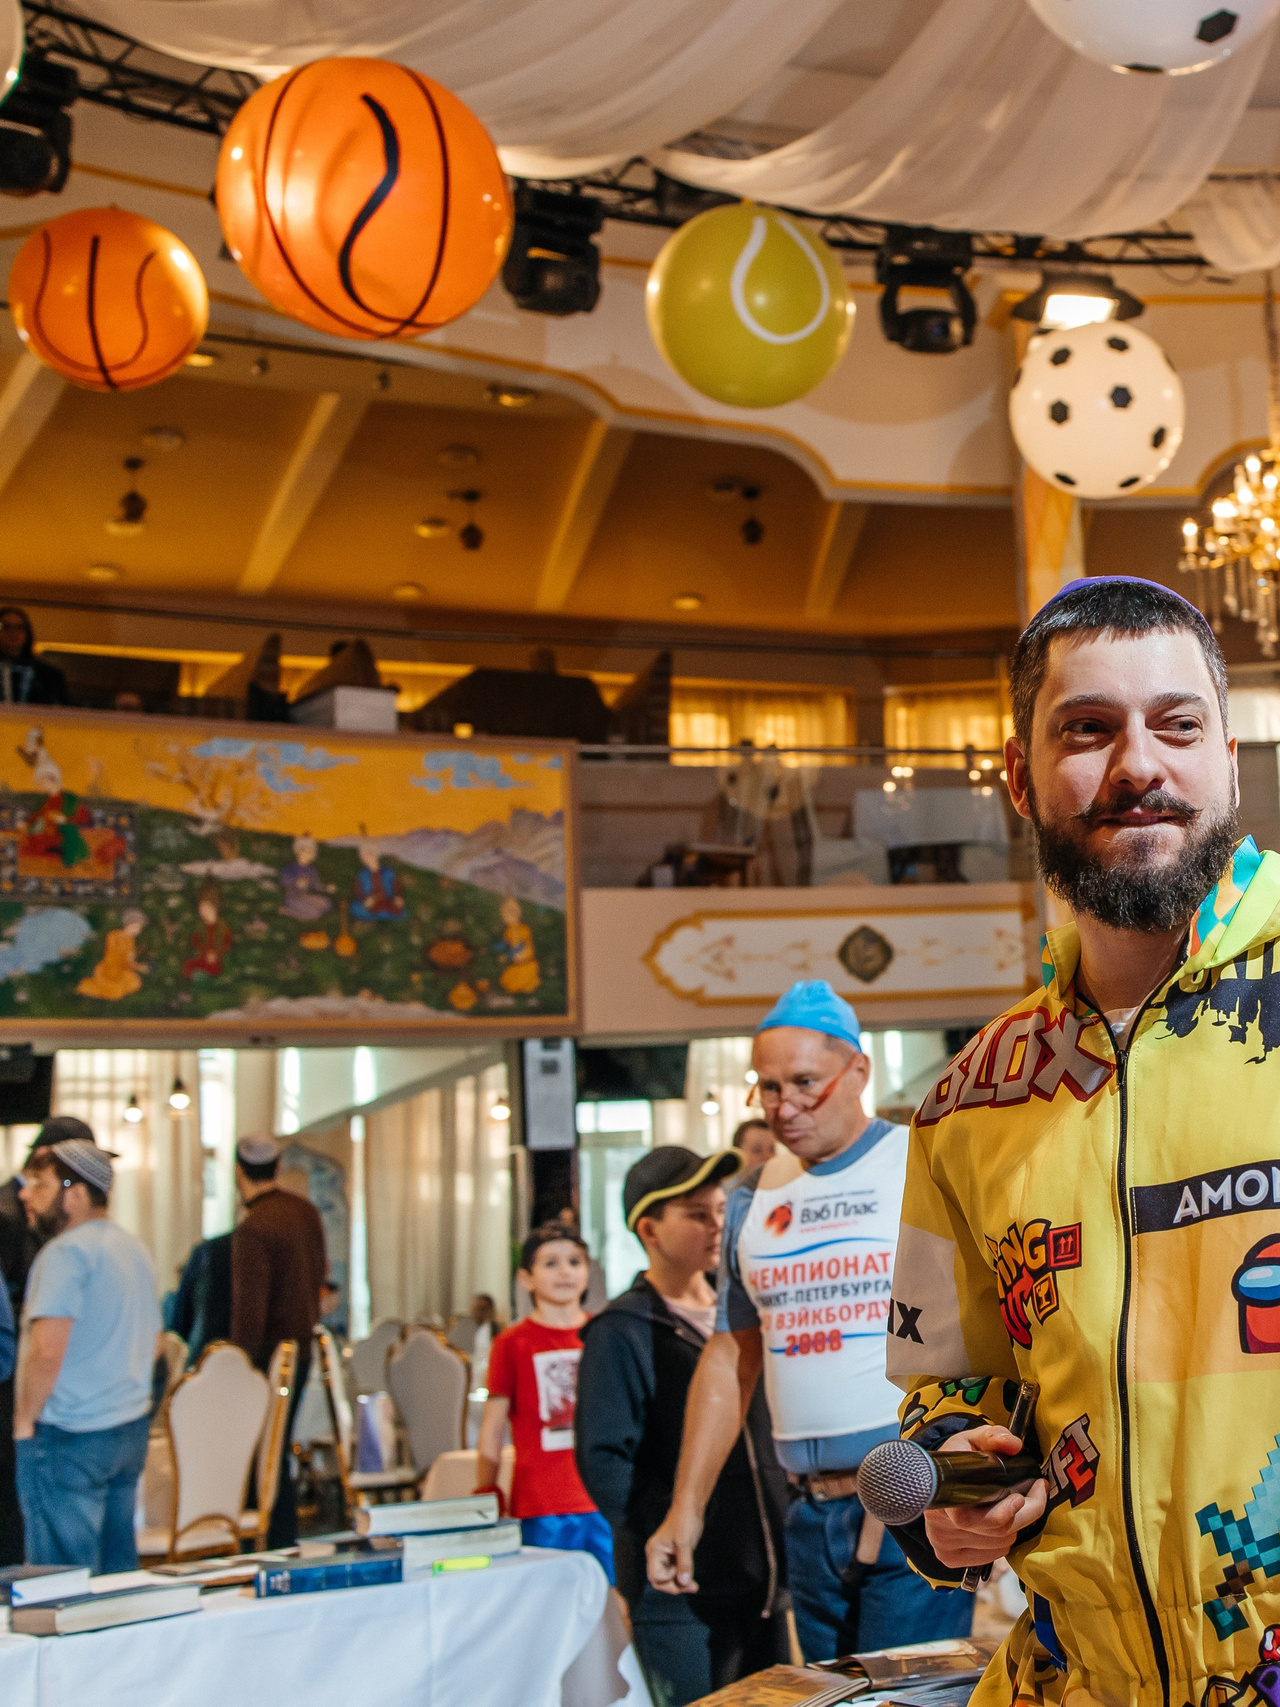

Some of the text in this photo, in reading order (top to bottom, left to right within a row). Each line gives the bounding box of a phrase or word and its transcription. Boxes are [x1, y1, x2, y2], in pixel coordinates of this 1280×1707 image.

[749, 1252, 892, 1291] ЧЕМПИОНАТ
[775, 1299, 891, 1332] ВЭЙКБОРДУ
[785, 1328, 844, 1358] 2008
